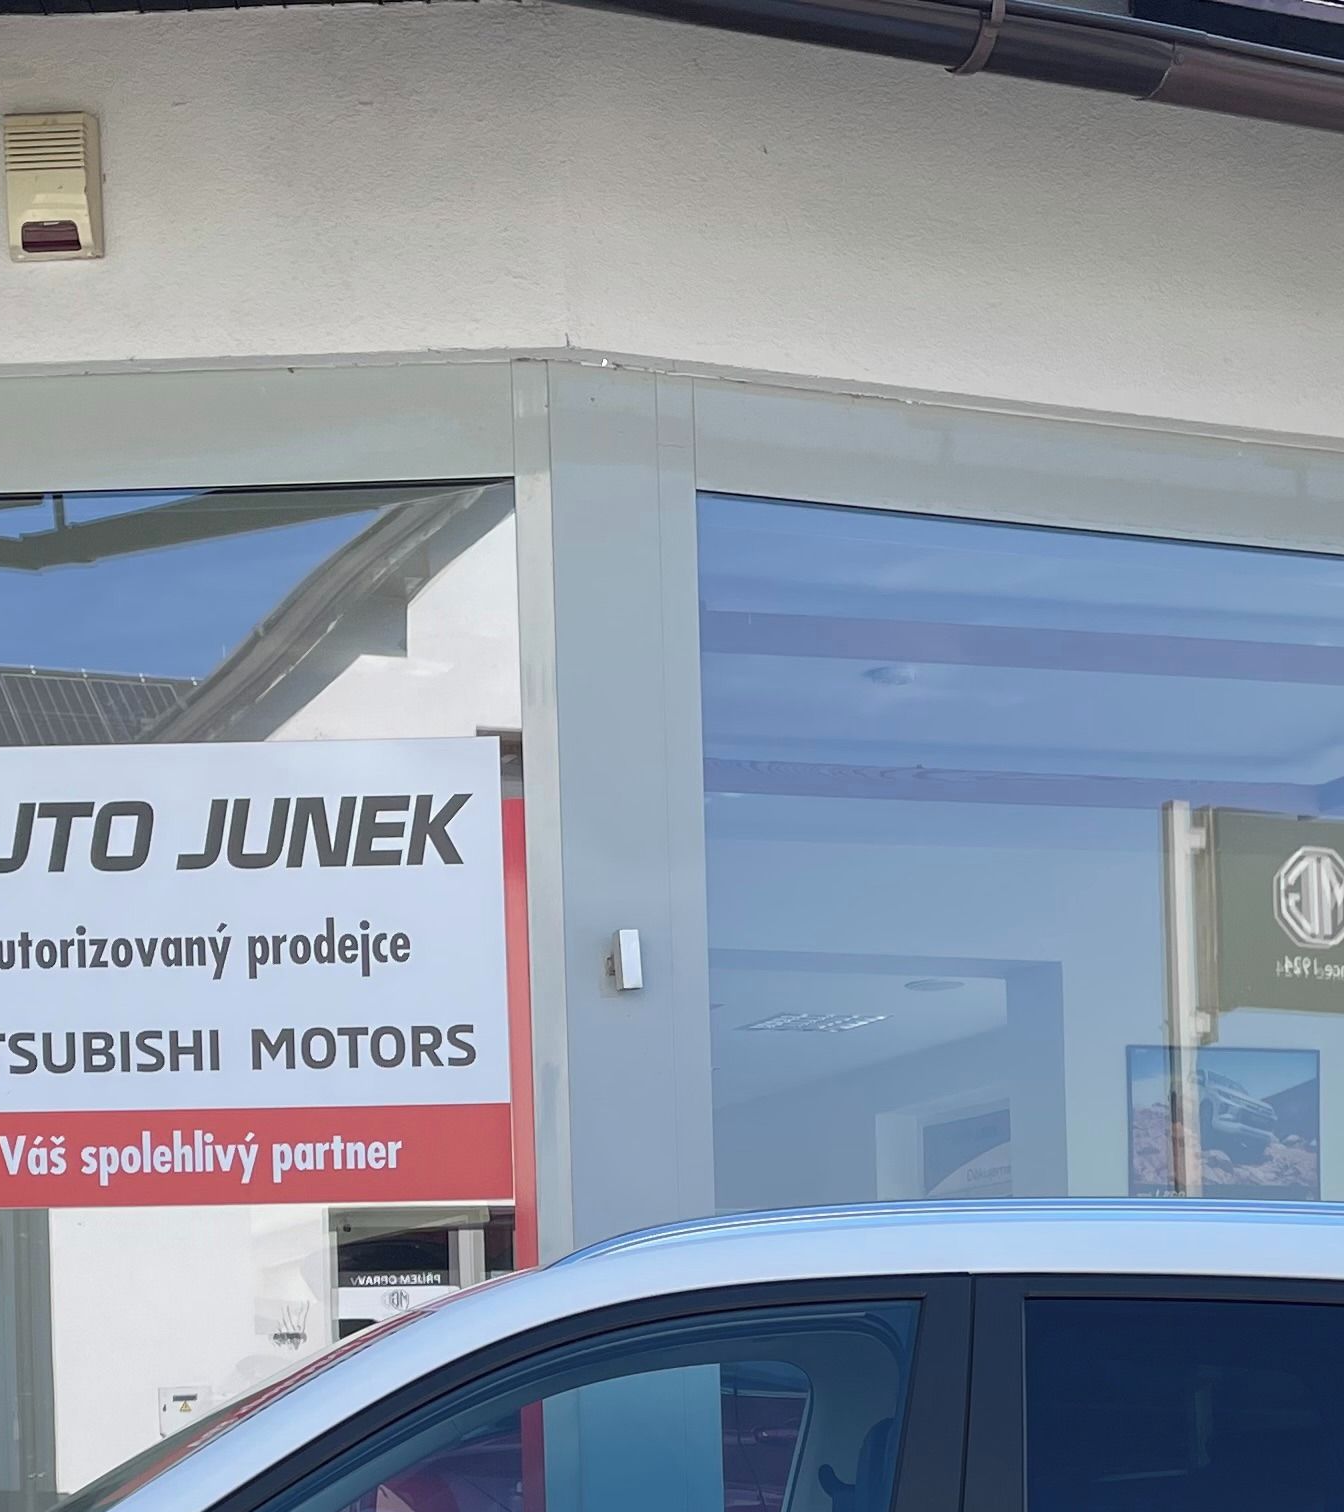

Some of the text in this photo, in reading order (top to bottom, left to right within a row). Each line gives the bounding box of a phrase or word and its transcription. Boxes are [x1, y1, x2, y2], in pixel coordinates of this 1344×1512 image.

[175, 792, 474, 870] JUNEK
[247, 916, 411, 979] prodejce
[250, 1023, 477, 1071] MOTORS
[80, 1129, 259, 1187] spolehlivý
[271, 1135, 403, 1183] partner
